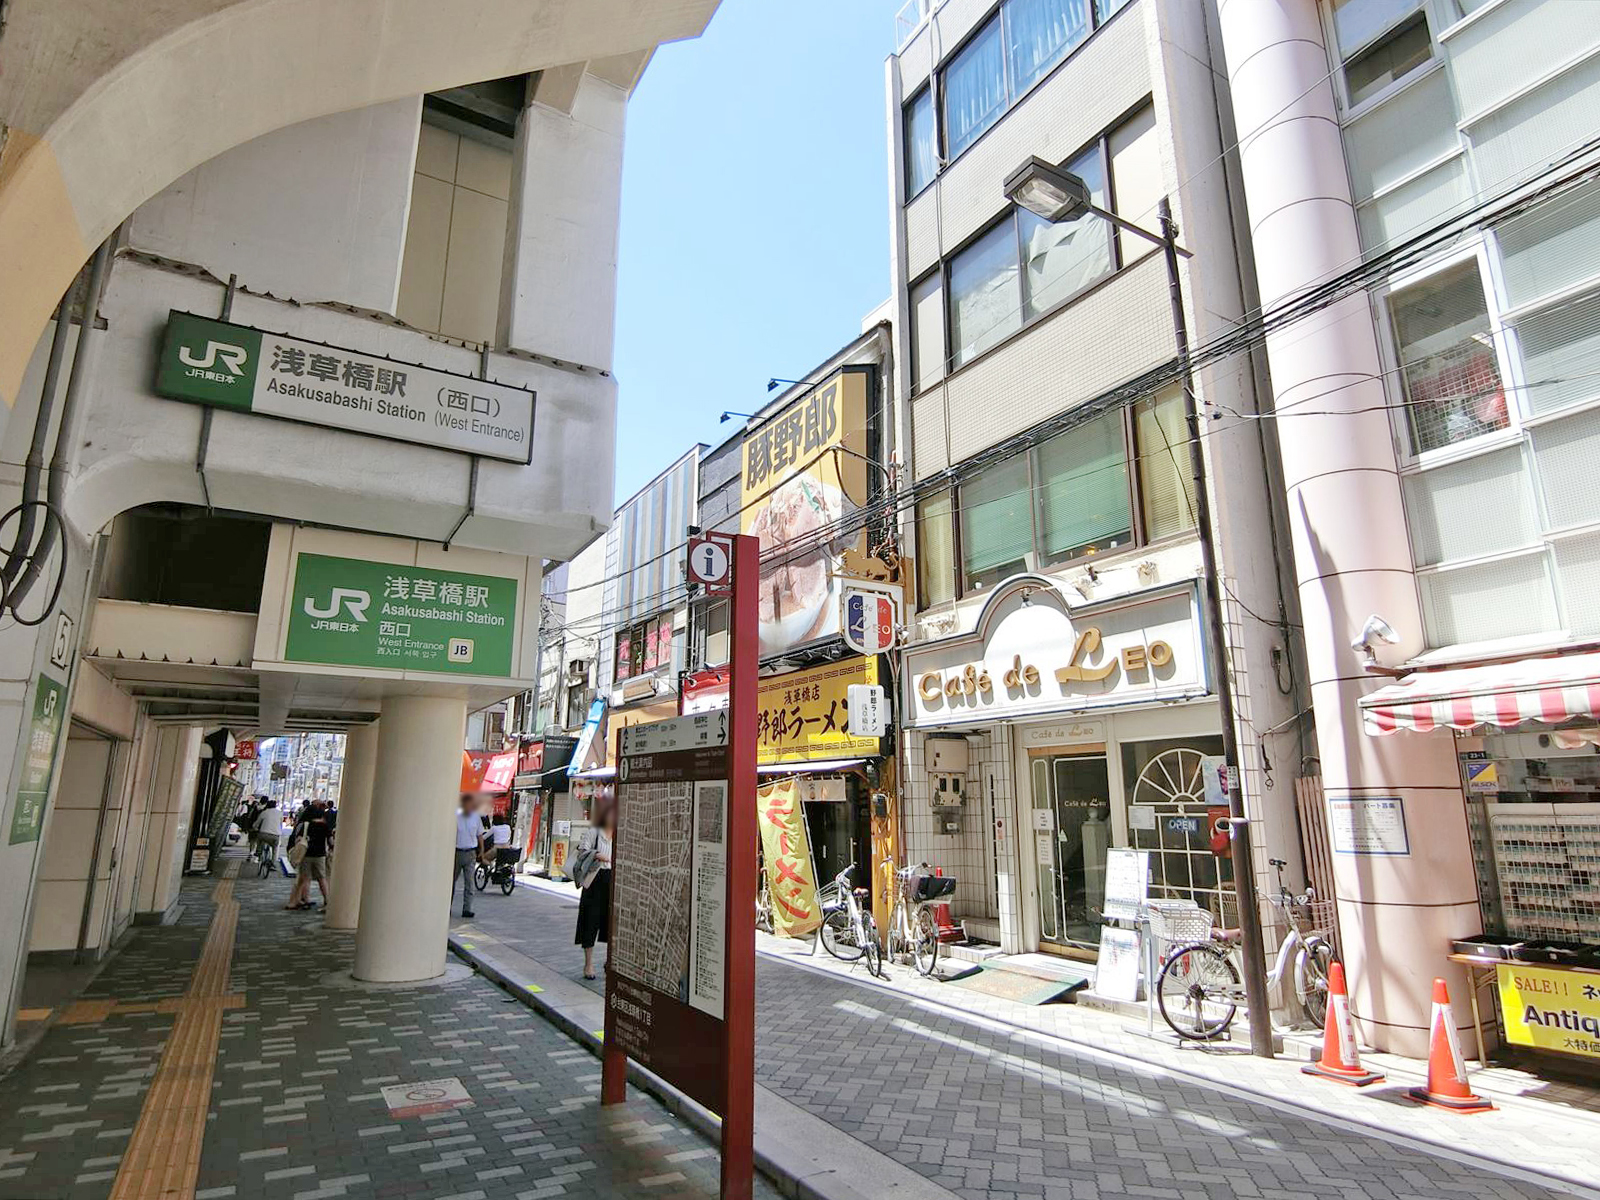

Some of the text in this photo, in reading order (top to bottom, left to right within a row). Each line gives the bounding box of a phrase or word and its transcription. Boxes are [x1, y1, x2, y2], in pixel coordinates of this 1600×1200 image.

[179, 340, 248, 377] JR
[270, 344, 408, 398] 浅草橋駅
[185, 367, 236, 385] JR東日本
[266, 377, 426, 422] Asakusabashi Station
[436, 386, 501, 418] （西口）
[434, 409, 525, 443] (West Entrance)
[746, 382, 838, 491] 豚野郎
[303, 587, 371, 623] JR
[383, 575, 490, 609] 浅草橋駅
[311, 620, 360, 633] JR東日本
[379, 621, 411, 637] 西口
[381, 602, 505, 627] Asakusabashi Station
[378, 637, 445, 651] West Entrance
[453, 645, 468, 656] JB
[1003, 654, 1041, 688] de
[43, 689, 58, 718] JR
[783, 683, 820, 706] 浅草橋店
[1169, 818, 1196, 832] OPEN
[765, 798, 810, 920] ラーメン
[1513, 976, 1569, 997] SALE!!
